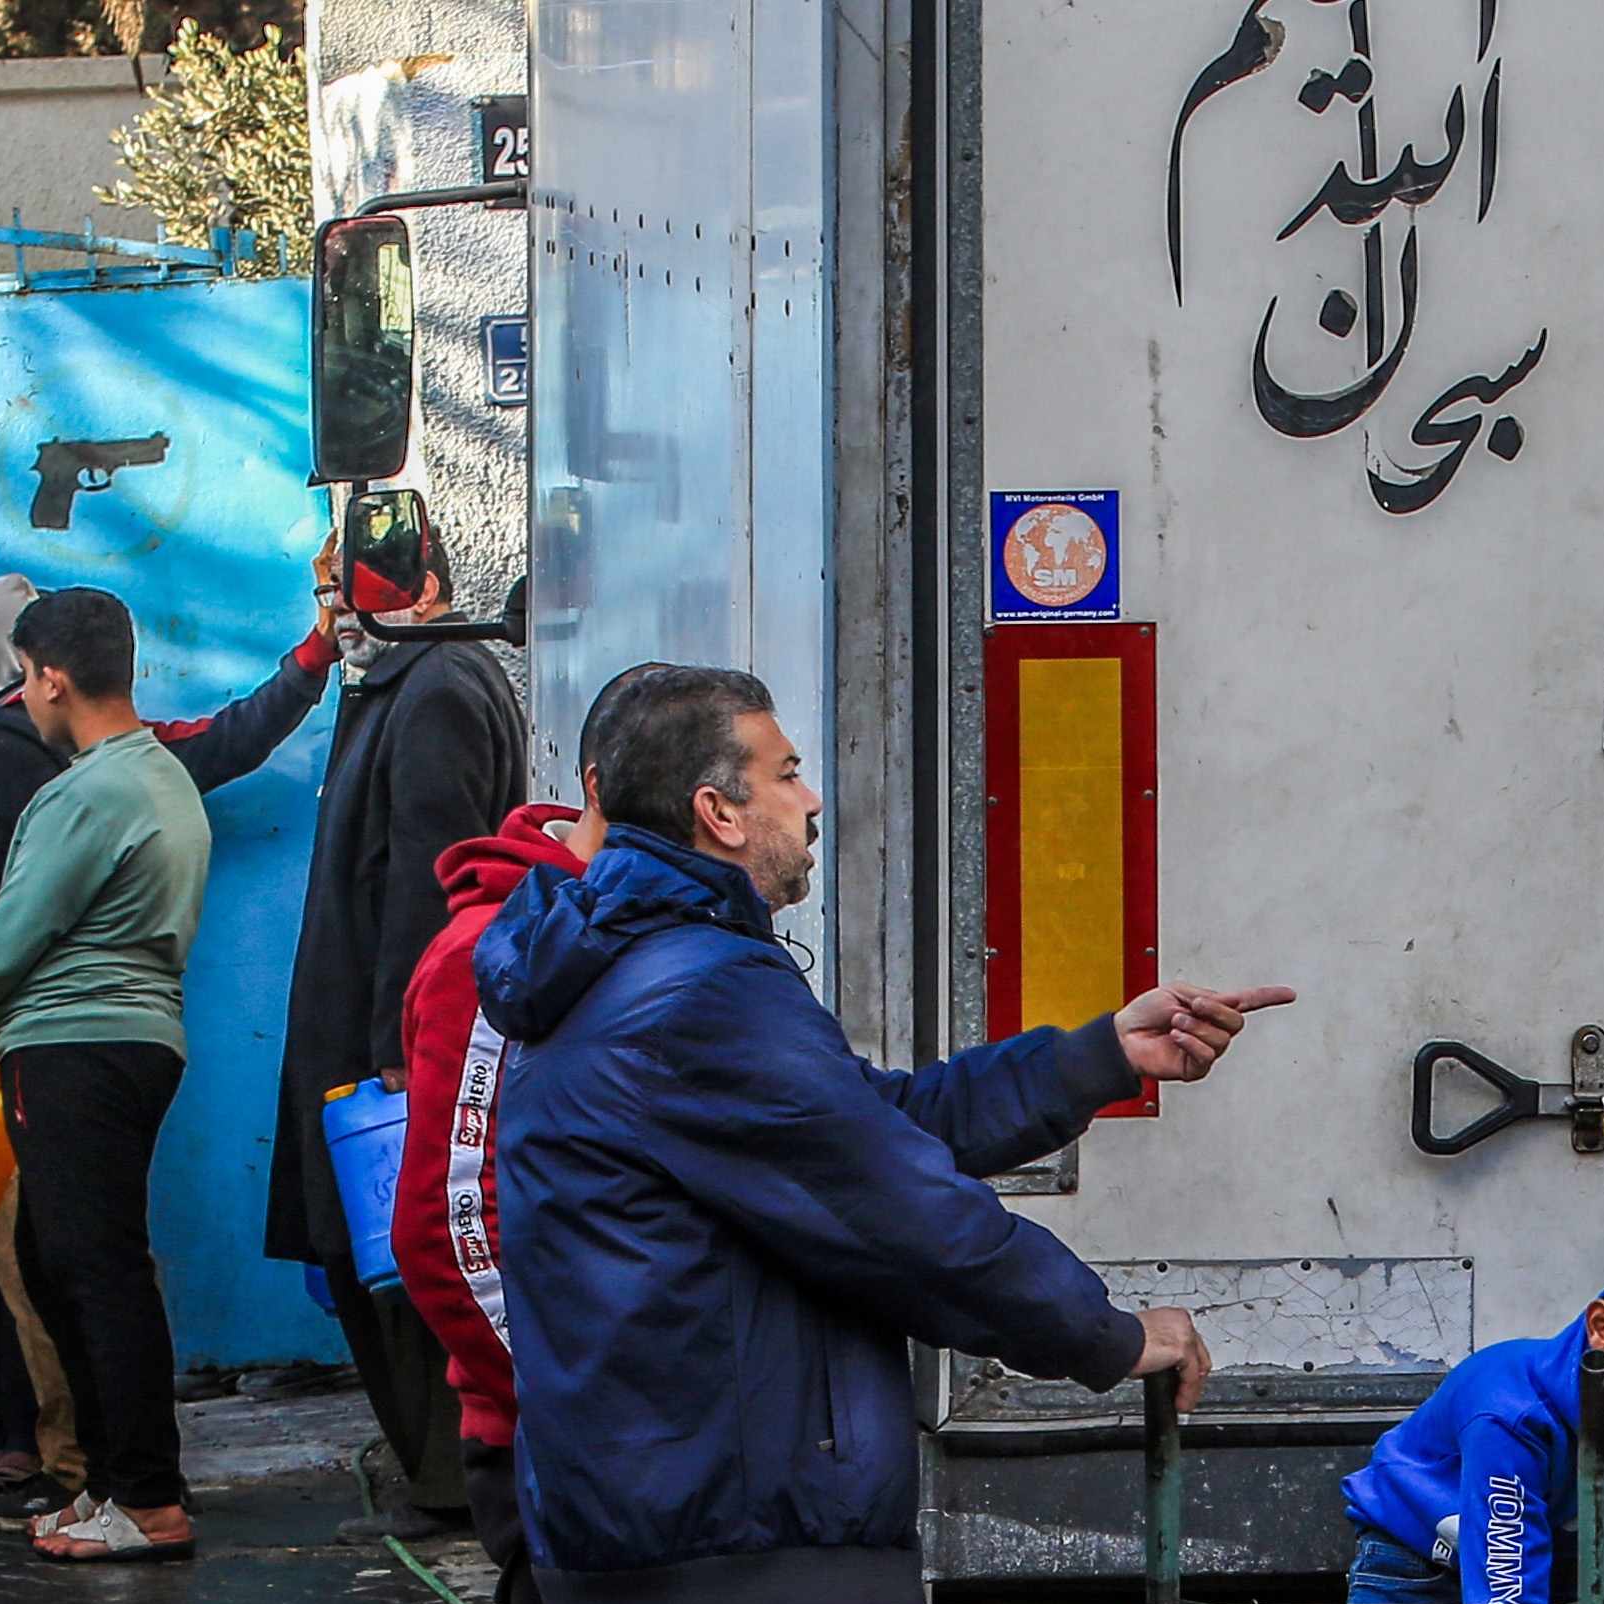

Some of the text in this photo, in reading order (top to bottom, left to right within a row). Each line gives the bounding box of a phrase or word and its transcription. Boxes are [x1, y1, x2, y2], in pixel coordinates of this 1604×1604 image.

[500, 368, 527, 393] 2
[1078, 494, 1105, 502] GmbH
[1033, 569, 1077, 587] SM
